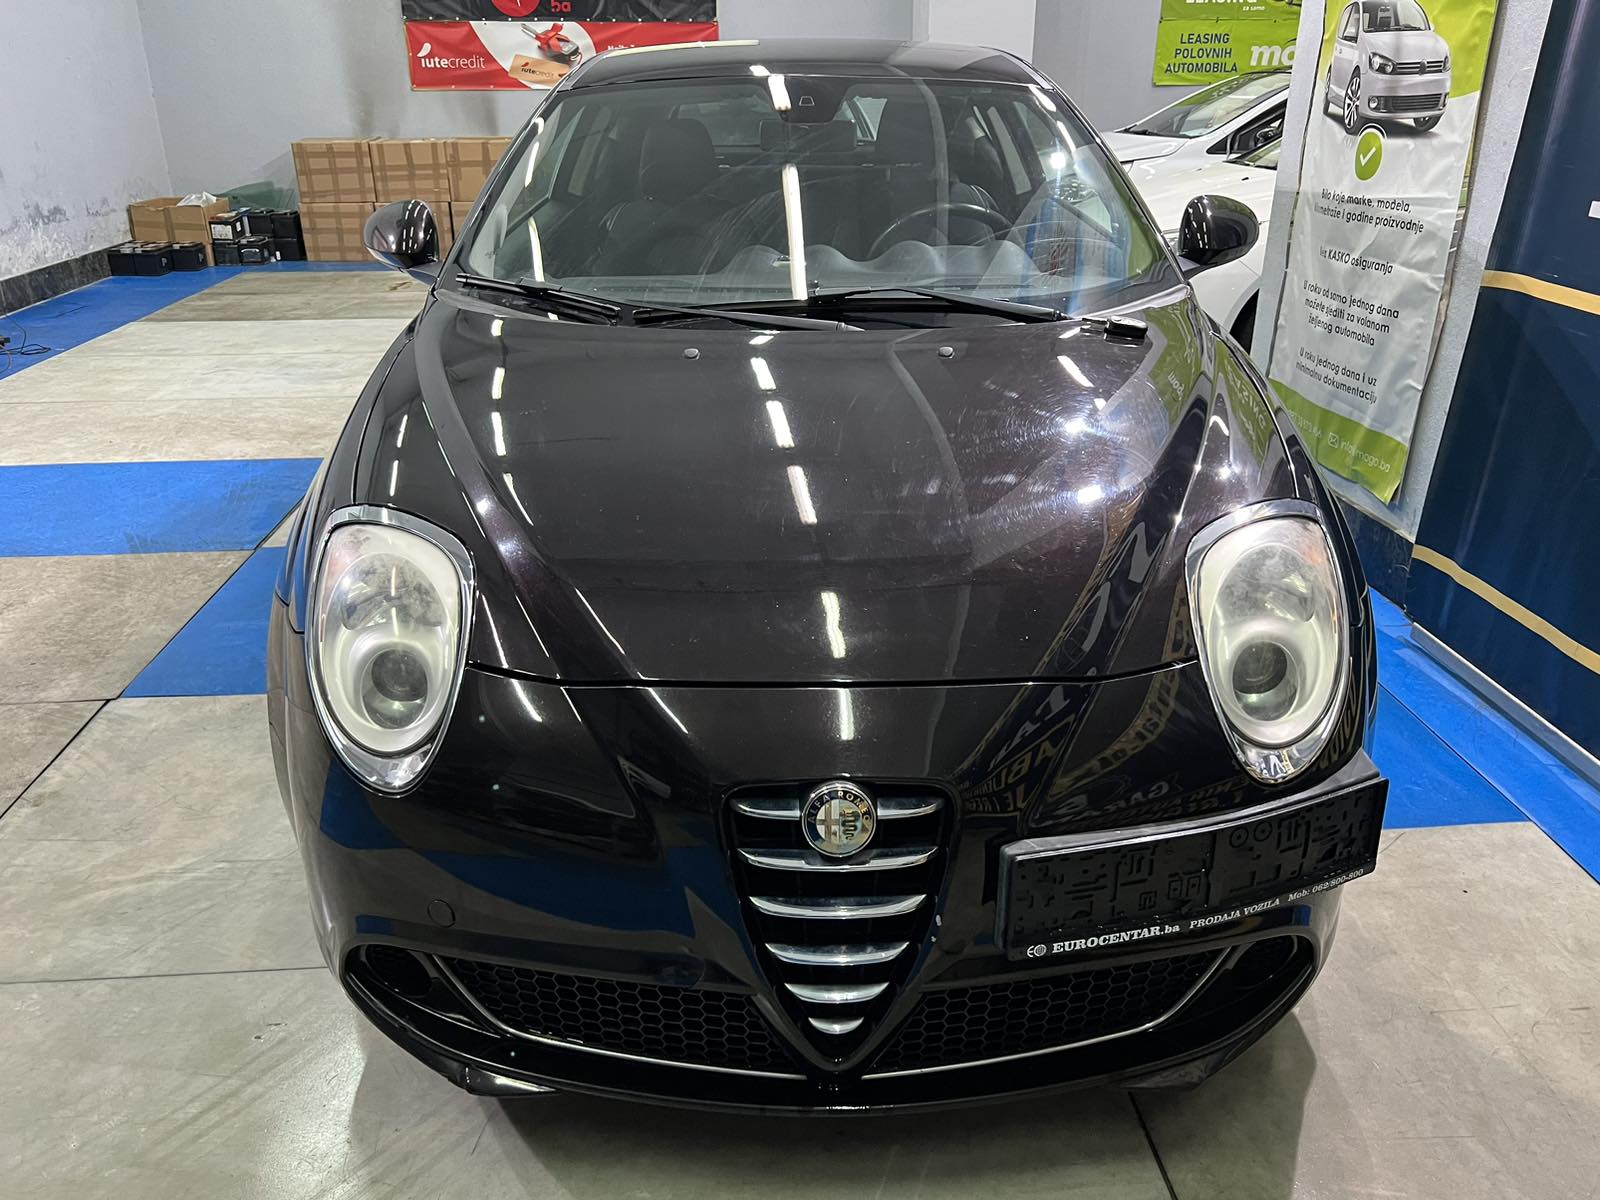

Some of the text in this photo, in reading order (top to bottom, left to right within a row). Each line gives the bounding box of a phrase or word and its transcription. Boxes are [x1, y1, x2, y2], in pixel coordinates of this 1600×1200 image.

[1180, 33, 1230, 44] LEASING
[1174, 48, 1232, 59] POLOVNIH
[1164, 62, 1238, 74] AUTOMOBILA
[1346, 195, 1375, 208] marke,
[1376, 199, 1412, 214] modela,
[1346, 210, 1374, 224] godine
[1374, 215, 1424, 235] proizvodnje
[1328, 249, 1351, 265] KASKO
[1350, 256, 1393, 276] osiguranja
[1308, 282, 1321, 295] roku
[1322, 286, 1329, 298] od
[1330, 291, 1347, 304] samo
[1349, 294, 1374, 314] jednog
[1376, 303, 1399, 319] dana
[1334, 323, 1375, 346] automobila
[1346, 312, 1355, 322] za
[1356, 314, 1390, 334] volanom
[1316, 352, 1340, 375] jednog
[1341, 365, 1360, 381] dana
[1367, 377, 1377, 387] uz
[1323, 374, 1378, 405] dokumentaciju
[808, 791, 871, 824] ALFA ROMEO
[1051, 923, 1180, 955] EUROCENTAR.ba
[1190, 908, 1242, 930] PRODAJA
[1243, 897, 1280, 918] VOZILA
[1288, 888, 1310, 902] Mob:
